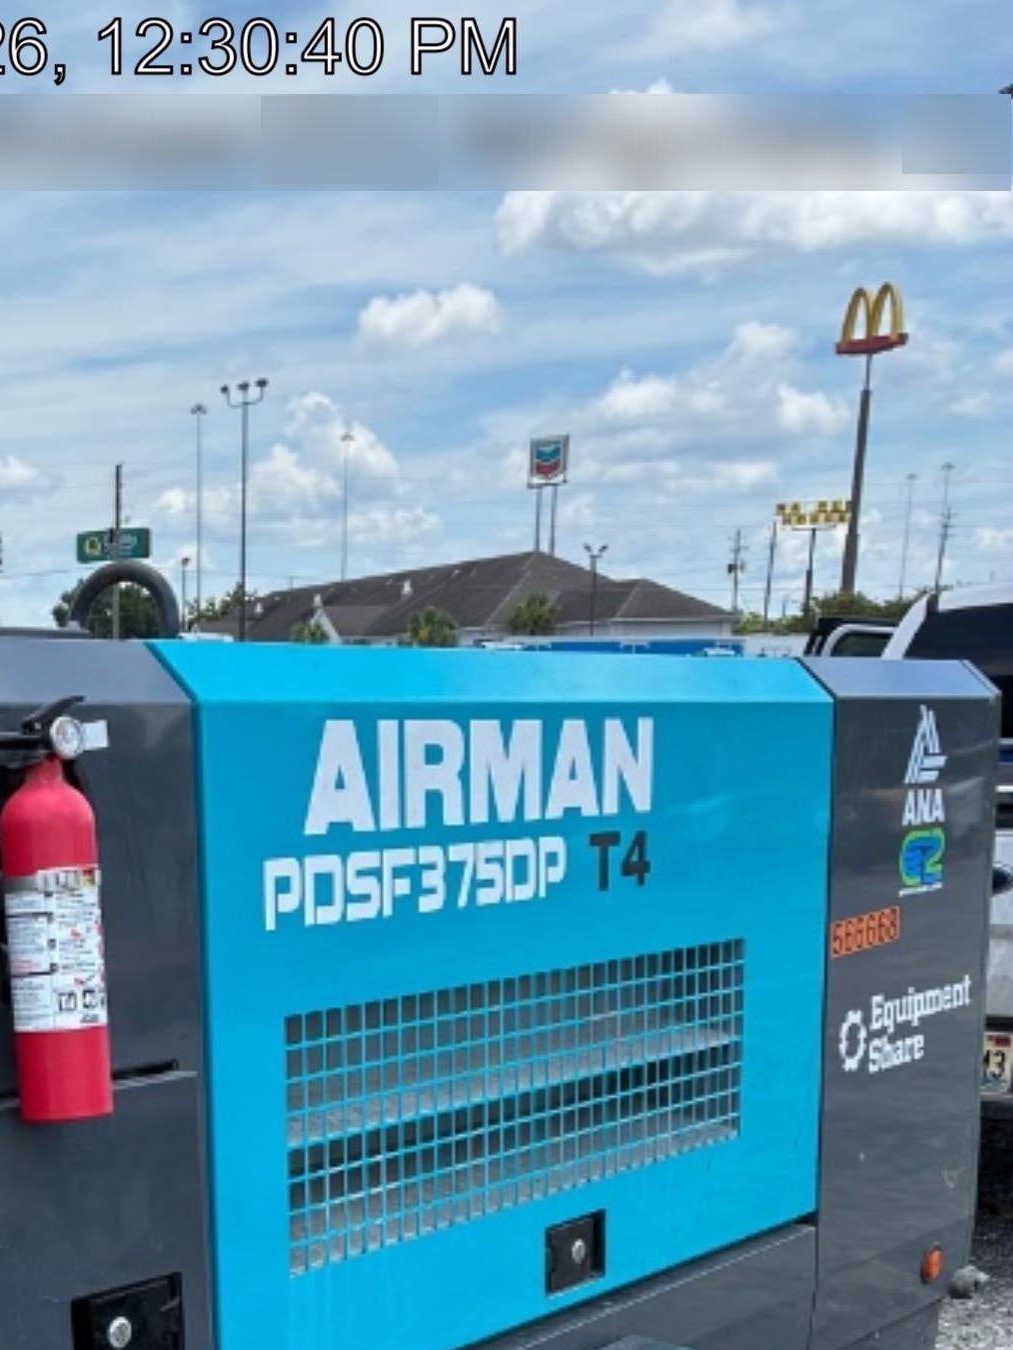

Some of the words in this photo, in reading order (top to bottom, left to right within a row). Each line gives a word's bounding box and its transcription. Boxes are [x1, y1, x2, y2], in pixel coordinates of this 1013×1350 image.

[303, 716, 654, 836] AIRMAN
[901, 787, 946, 826] ANA
[262, 835, 568, 932] PDSF375DP
[589, 830, 651, 892] T4
[869, 973, 973, 1034] Equipment
[868, 1034, 925, 1074] Share
